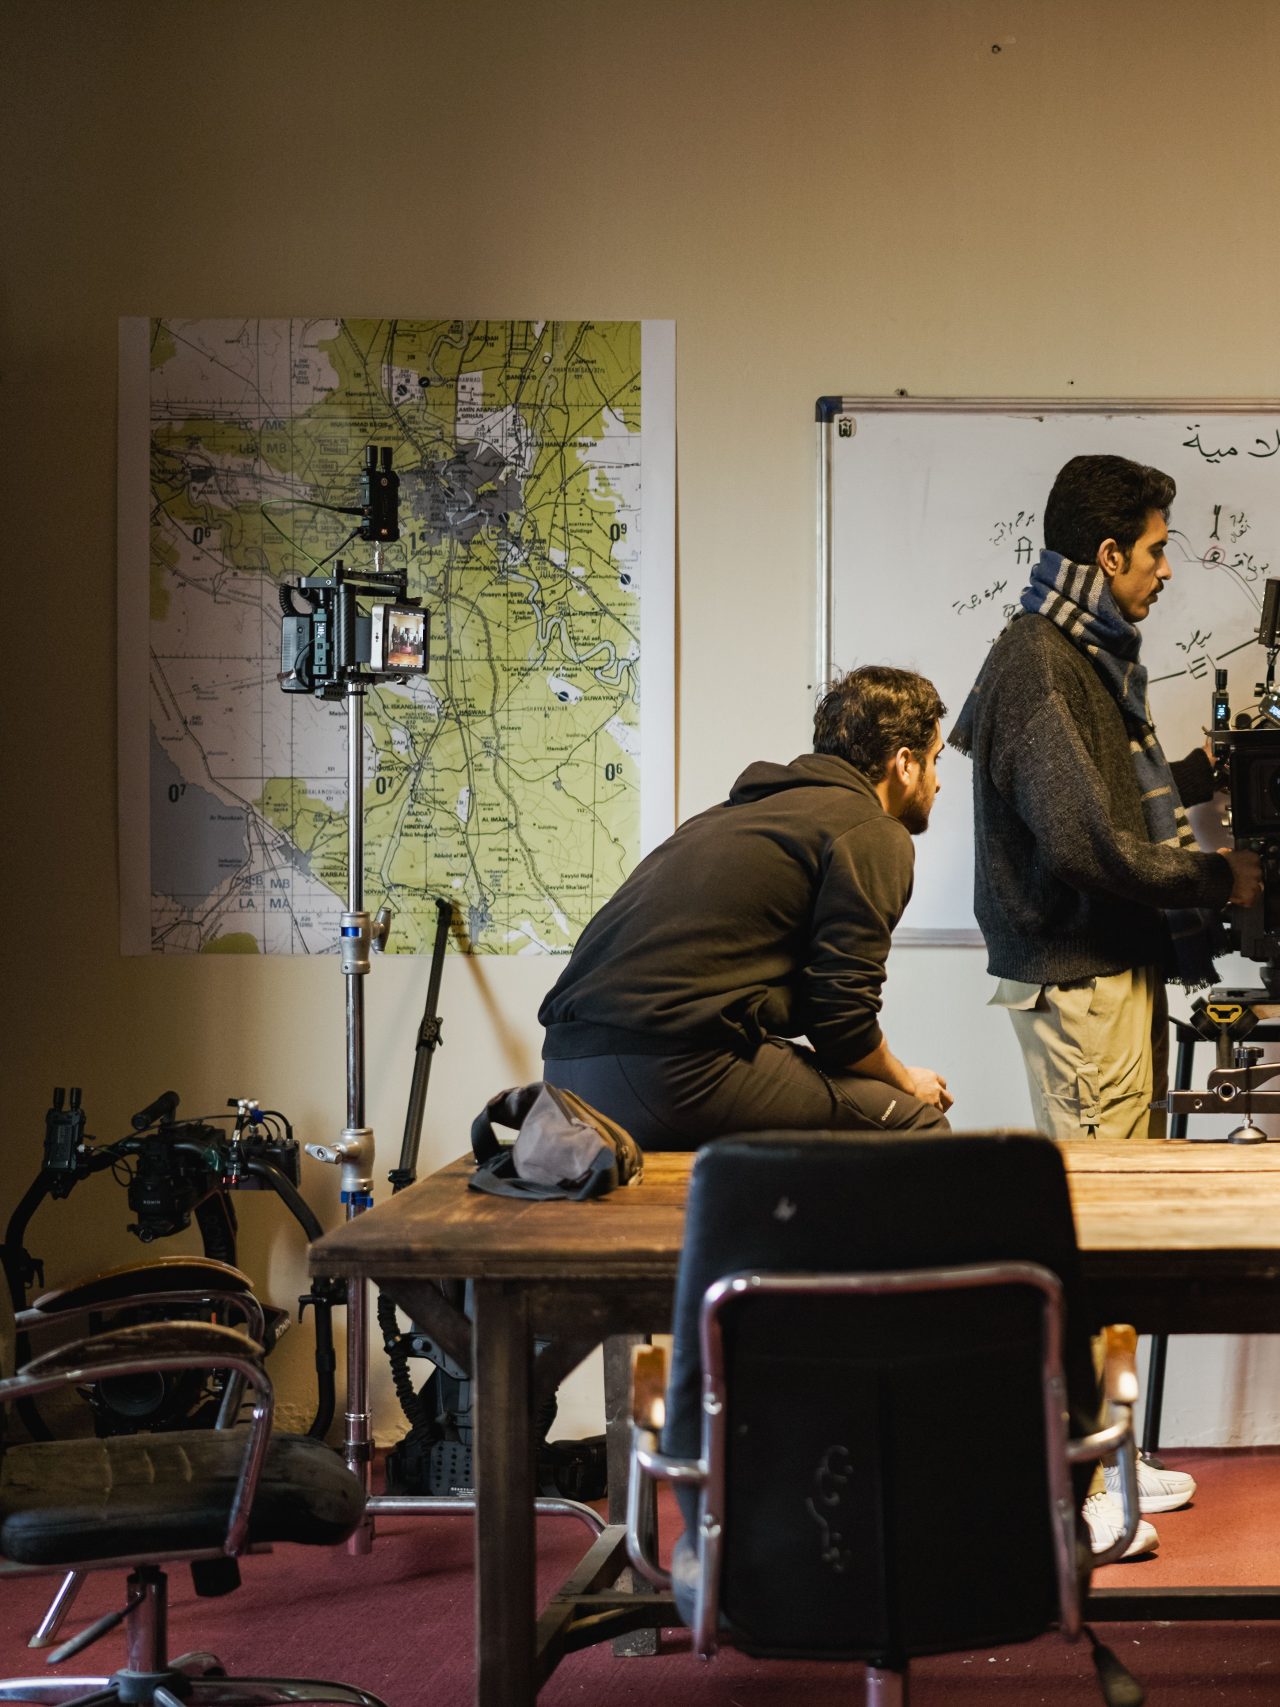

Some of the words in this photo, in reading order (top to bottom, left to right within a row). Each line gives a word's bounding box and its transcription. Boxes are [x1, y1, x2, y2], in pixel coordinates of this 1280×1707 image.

[605, 763, 623, 780] 06
[270, 879, 290, 889] MB
[269, 898, 290, 908] MA
